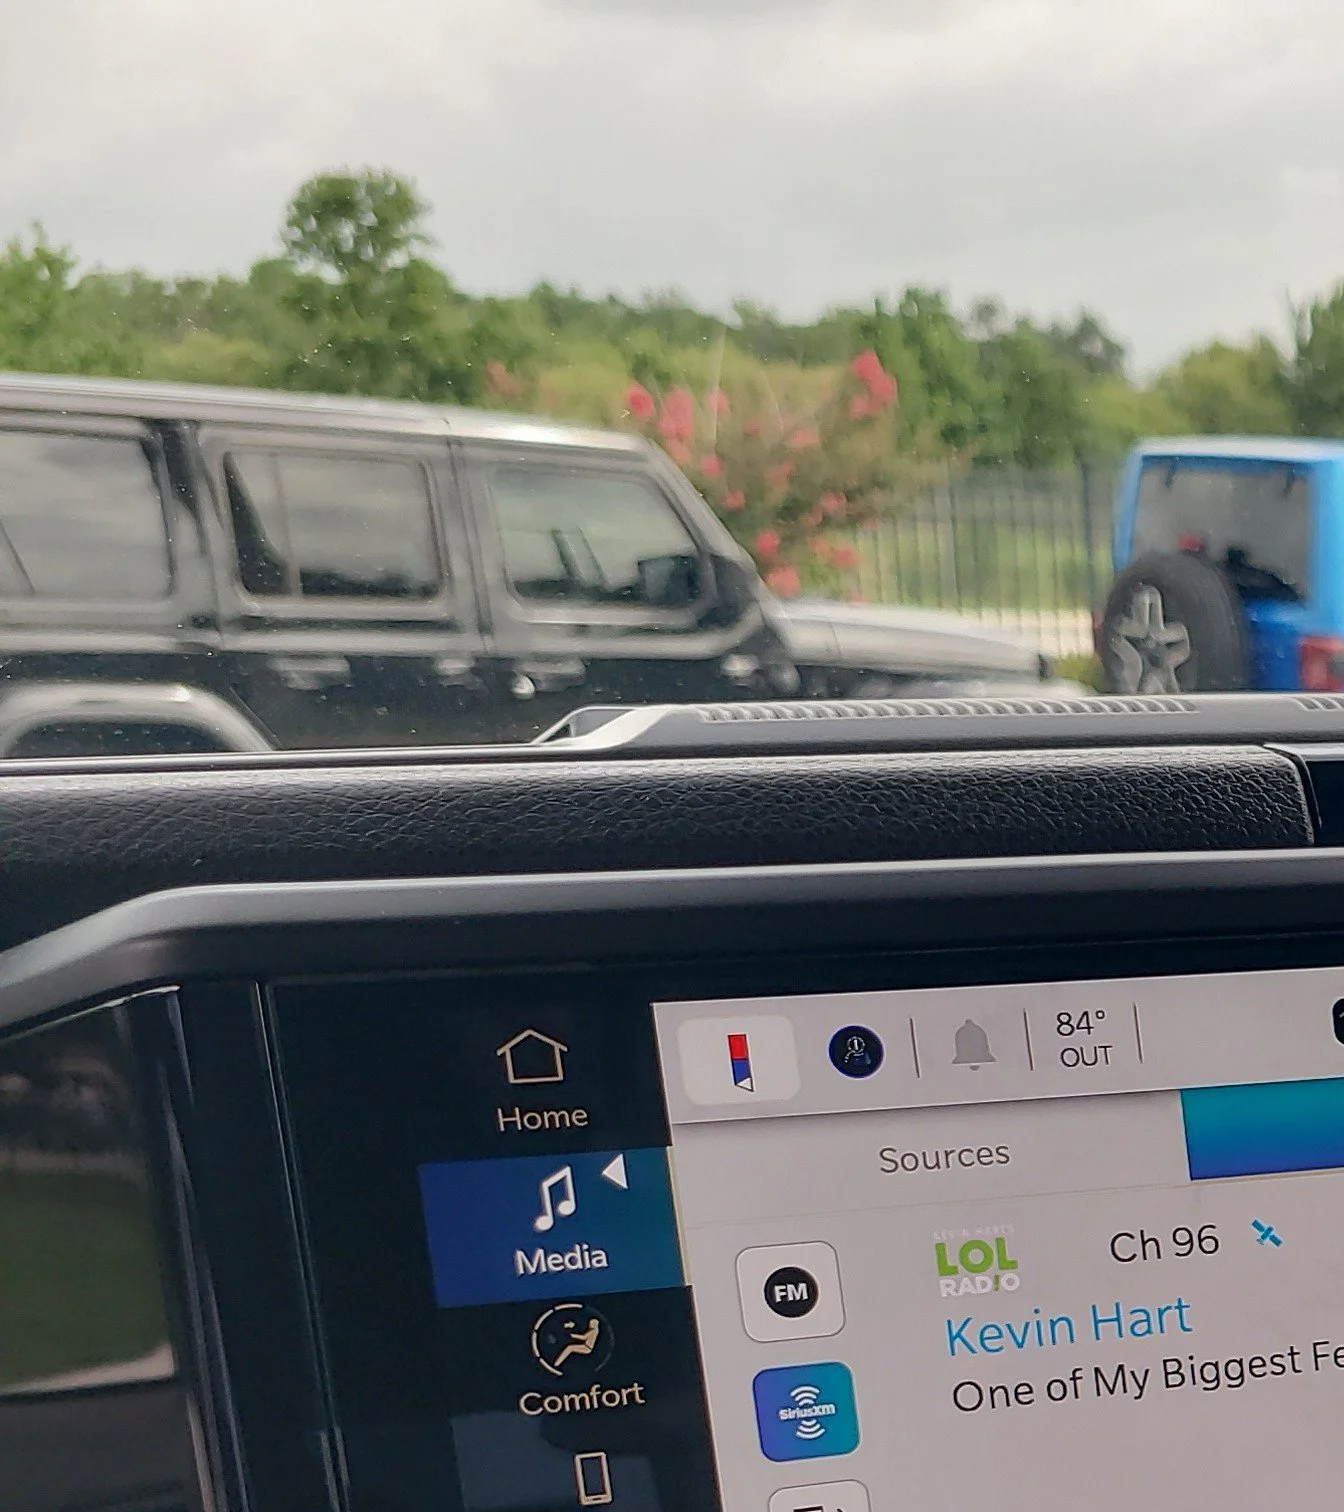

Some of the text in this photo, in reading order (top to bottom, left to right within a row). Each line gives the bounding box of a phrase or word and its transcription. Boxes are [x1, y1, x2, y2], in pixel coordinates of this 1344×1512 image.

[1060, 1045, 1114, 1068] OUT
[497, 1106, 589, 1134] Home
[878, 1141, 1011, 1176] Sources
[514, 1245, 609, 1276] Media
[935, 1237, 1019, 1277] LOL
[1110, 1225, 1220, 1263] Ch 96
[774, 1283, 809, 1303] FM
[946, 1297, 1192, 1357] Kevin Hart
[953, 1379, 1035, 1412] One
[1045, 1367, 1084, 1403] of
[1094, 1363, 1150, 1405] My
[1162, 1344, 1302, 1392] Biggest
[519, 1382, 645, 1417] Comfort
